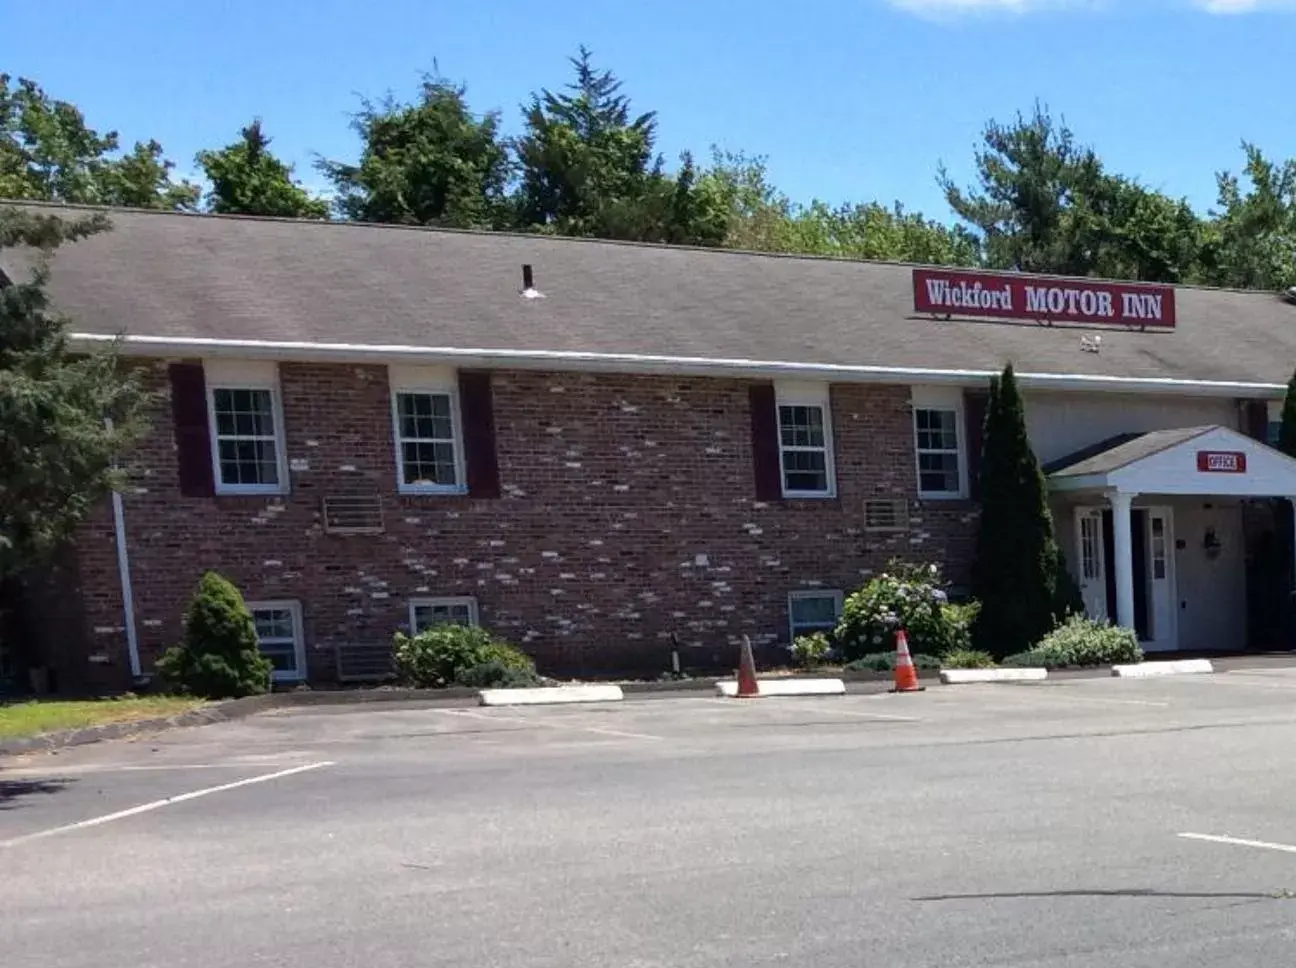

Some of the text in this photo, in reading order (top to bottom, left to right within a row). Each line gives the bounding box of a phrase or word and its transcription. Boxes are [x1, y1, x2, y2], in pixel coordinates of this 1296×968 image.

[925, 279, 1163, 319] Wickford MOTOR INN
[1208, 454, 1237, 469] OFFICE
